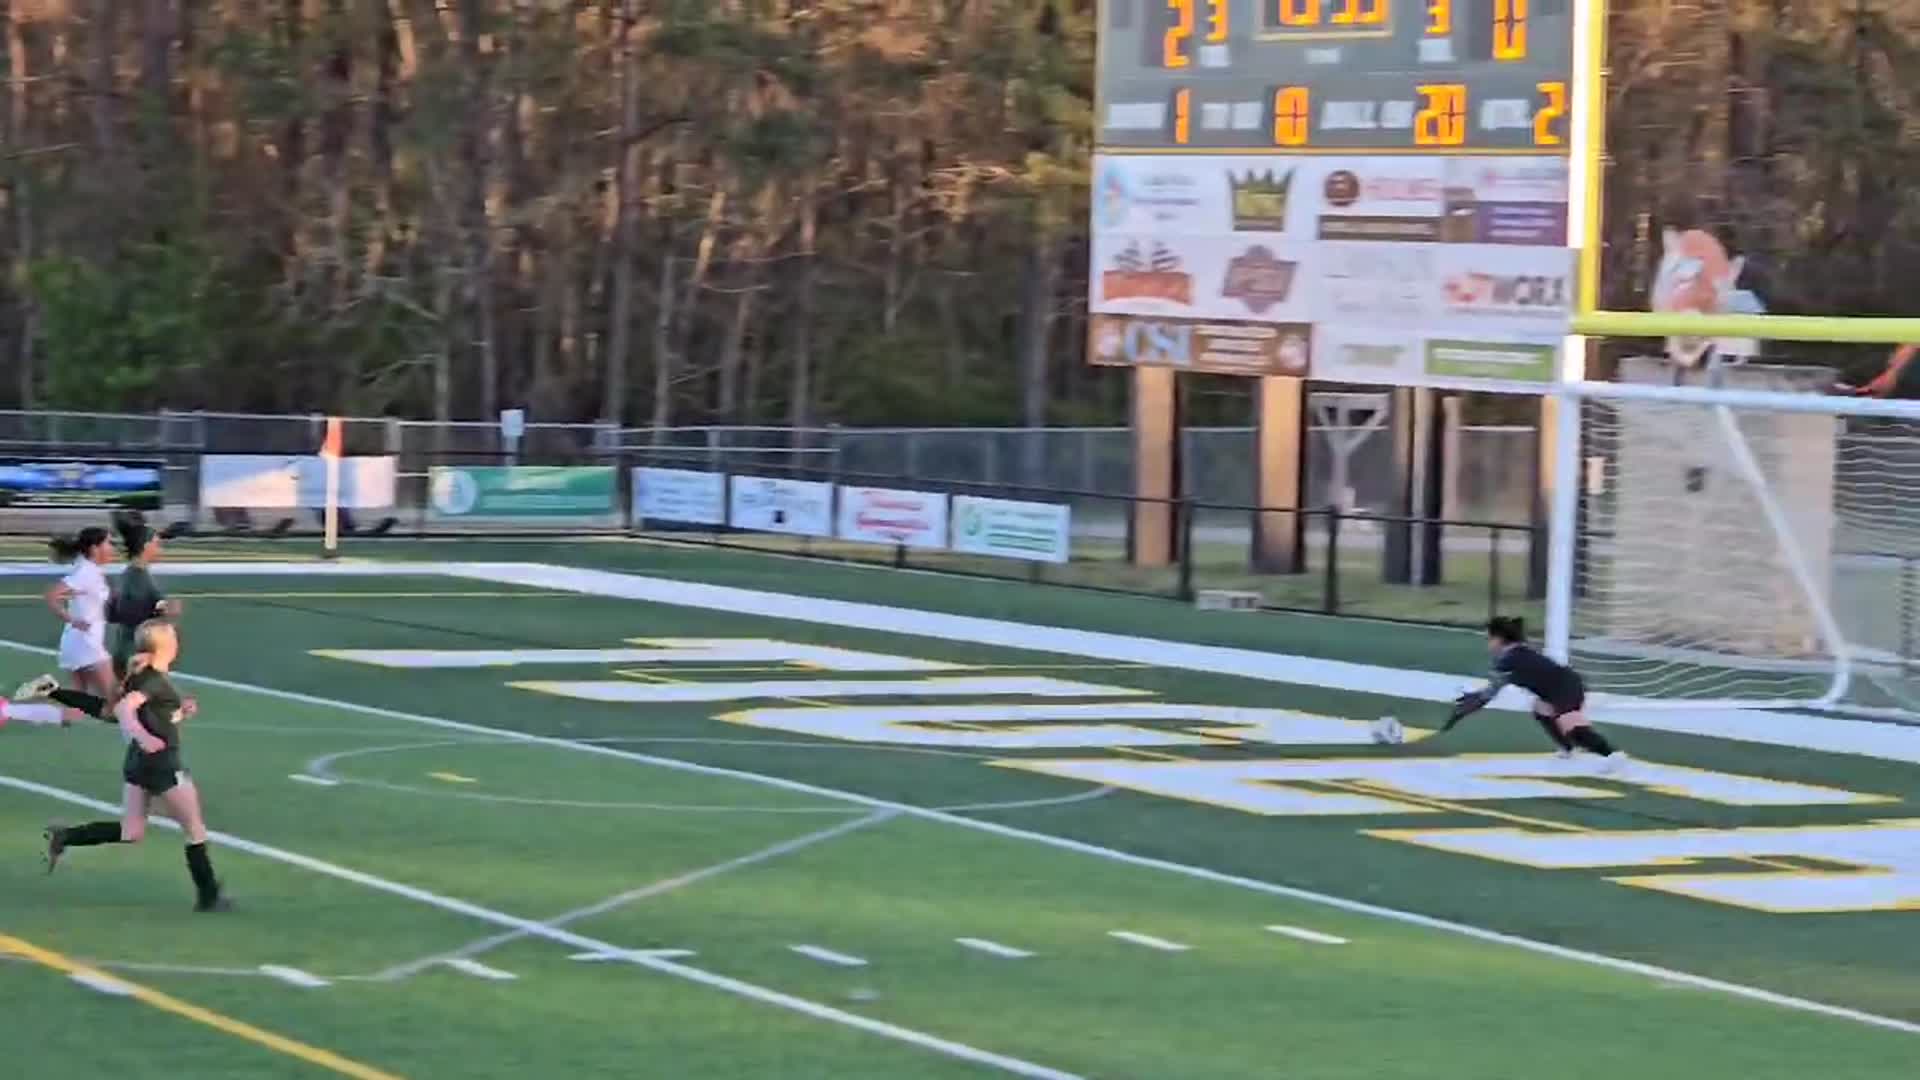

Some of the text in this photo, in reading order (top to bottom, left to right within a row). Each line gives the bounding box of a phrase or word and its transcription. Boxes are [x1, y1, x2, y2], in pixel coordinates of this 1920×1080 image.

[1174, 88, 1191, 144] 1
[1273, 86, 1310, 145] 0
[1414, 83, 1467, 145] 20
[1533, 82, 1566, 144] 2
